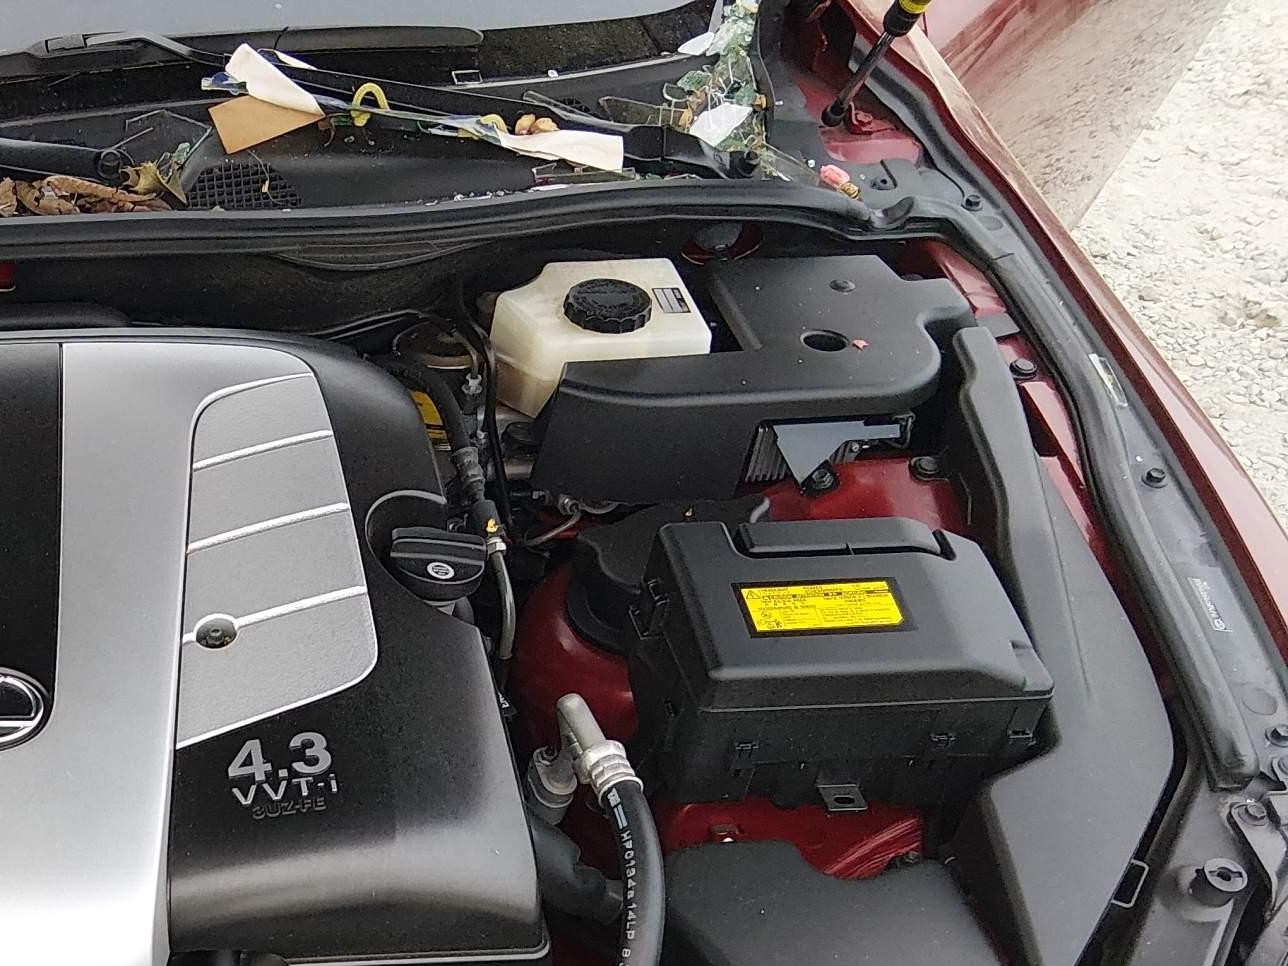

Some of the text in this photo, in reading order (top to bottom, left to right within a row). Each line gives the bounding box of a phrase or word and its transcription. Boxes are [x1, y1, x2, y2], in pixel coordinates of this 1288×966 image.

[227, 731, 332, 782] 4.3
[232, 773, 338, 806] VVT-i
[251, 797, 327, 820] 3UZ-FE
